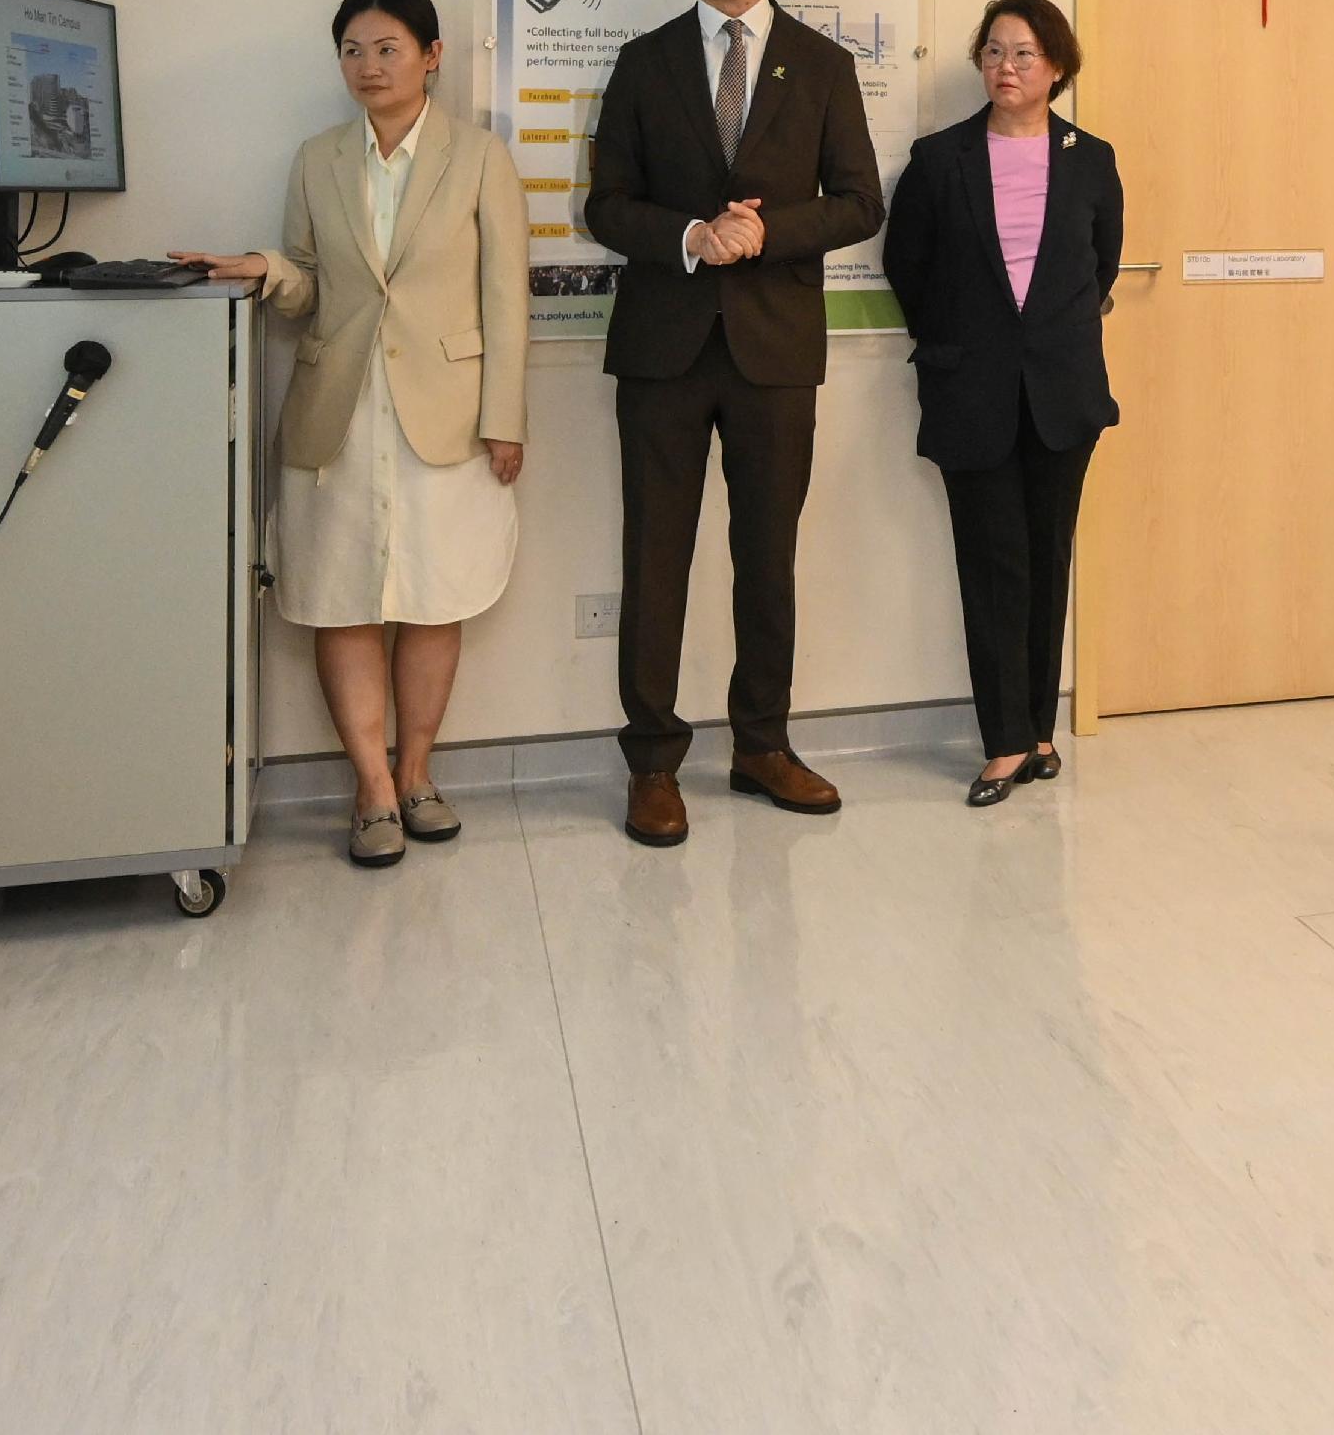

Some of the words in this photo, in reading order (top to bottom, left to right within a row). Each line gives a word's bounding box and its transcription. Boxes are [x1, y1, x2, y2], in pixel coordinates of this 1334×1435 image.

[531, 27, 582, 39] Collecting
[584, 28, 601, 38] full
[603, 28, 629, 40] body
[527, 42, 549, 52] with
[552, 43, 594, 53] thirteen
[527, 56, 584, 69] performing
